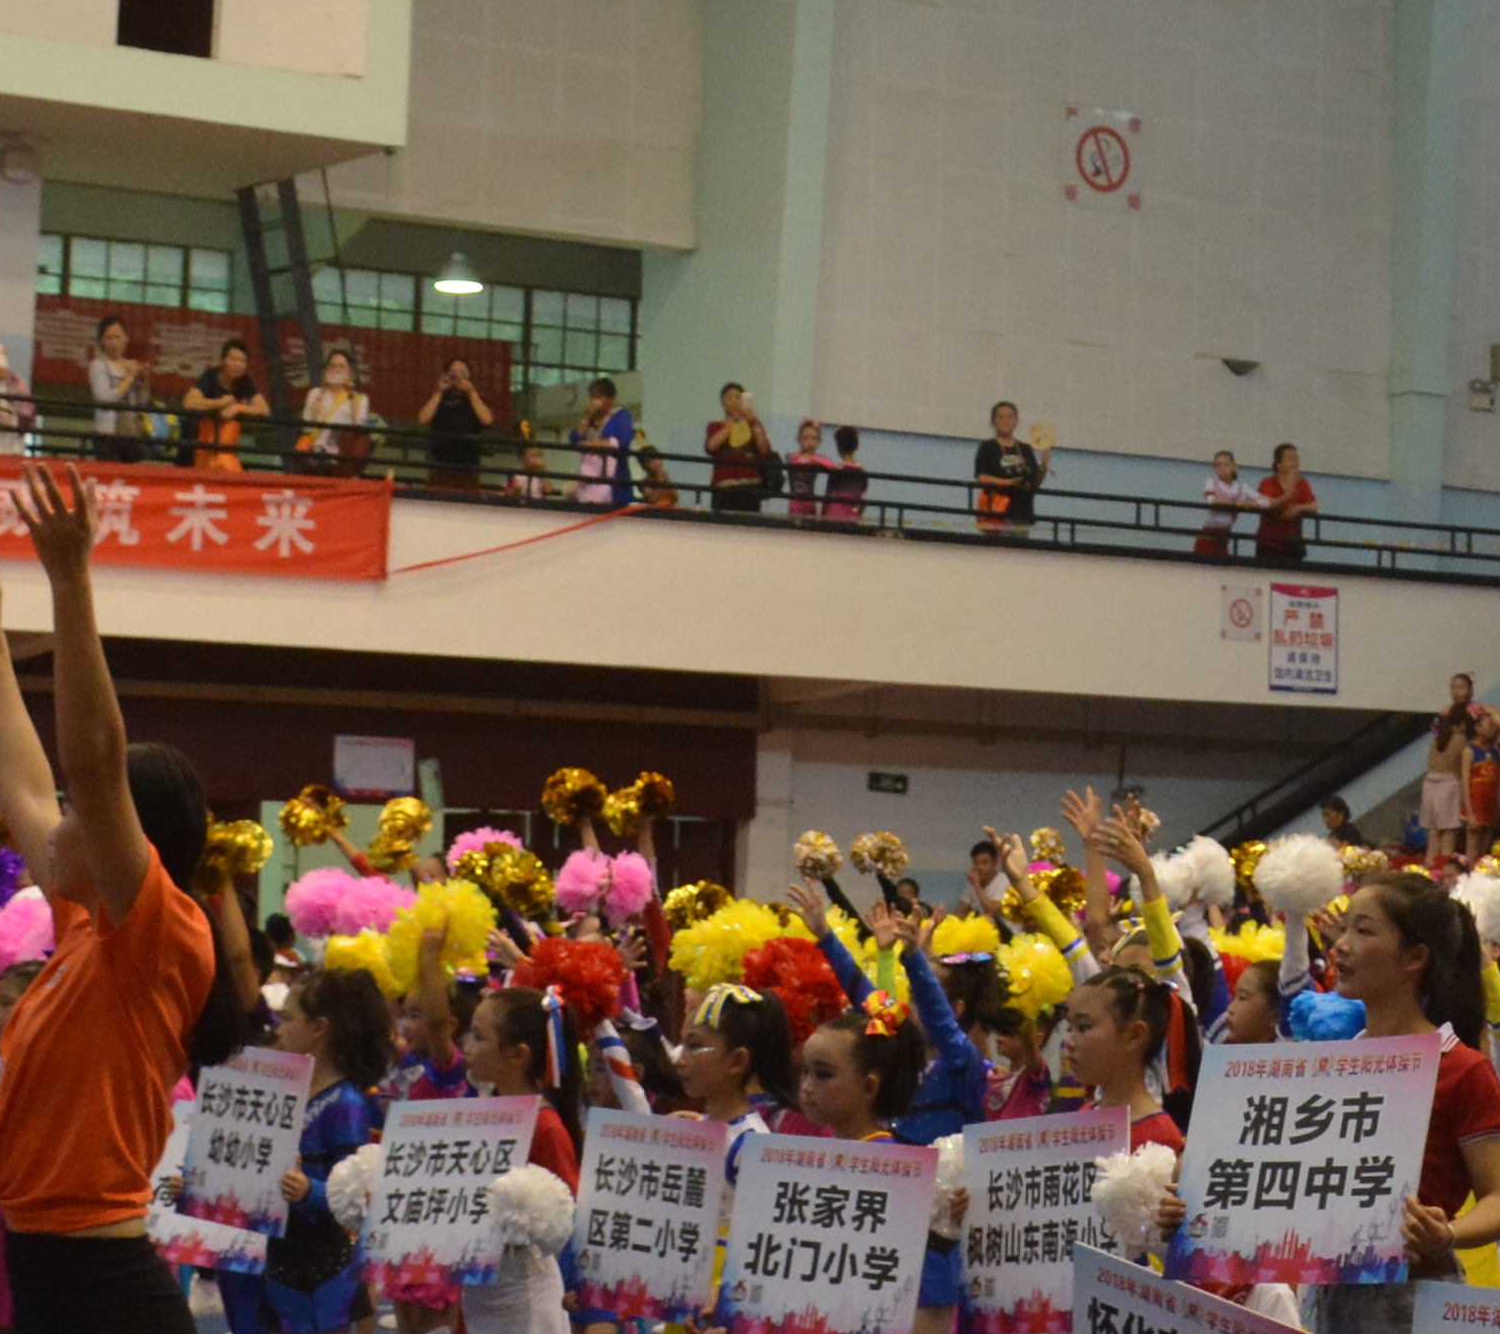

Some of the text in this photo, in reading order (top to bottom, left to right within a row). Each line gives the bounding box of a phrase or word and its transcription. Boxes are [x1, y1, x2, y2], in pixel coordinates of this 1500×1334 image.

[201, 1079, 298, 1130] 长沙市天心区
[1238, 1091, 1385, 1147] 湘乡市
[383, 1138, 518, 1178] 长沙市天心区
[594, 1153, 708, 1209] 长沙市岳麓
[1202, 1157, 1396, 1213] 第四中学
[380, 1184, 491, 1226] 文庙坪小学
[772, 1179, 889, 1235] 张家界
[988, 1161, 1098, 1212] 长沙市雨花区
[587, 1207, 702, 1264] 区第二小学
[744, 1232, 901, 1291] 北门小学
